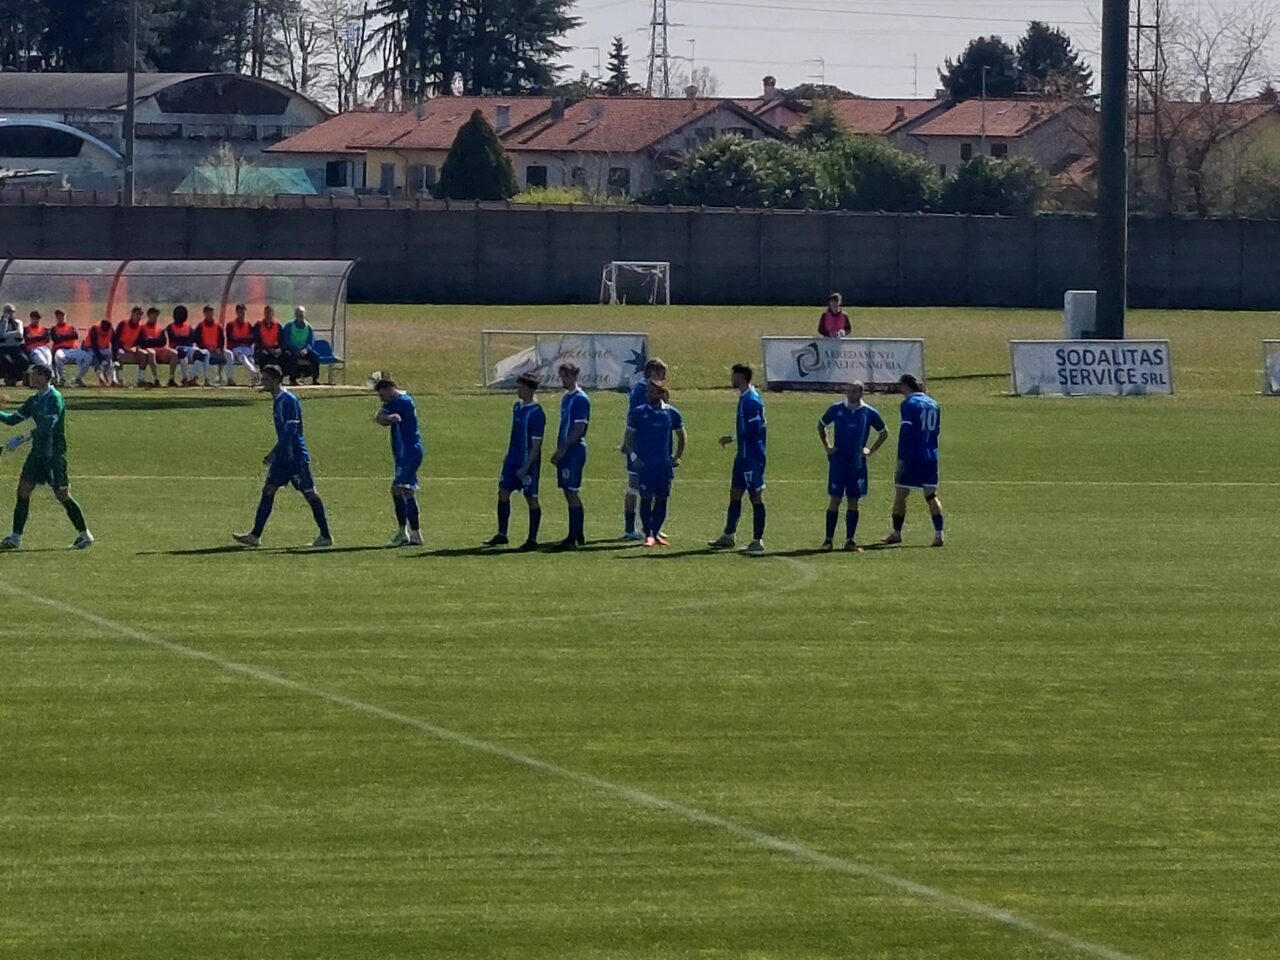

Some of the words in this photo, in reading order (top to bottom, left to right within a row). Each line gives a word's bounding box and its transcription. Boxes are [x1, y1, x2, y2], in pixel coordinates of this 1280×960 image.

[1055, 348, 1164, 367] SODALITAS
[1058, 368, 1138, 386] SERVICE
[1140, 372, 1167, 386] SRL
[920, 408, 938, 431] 10
